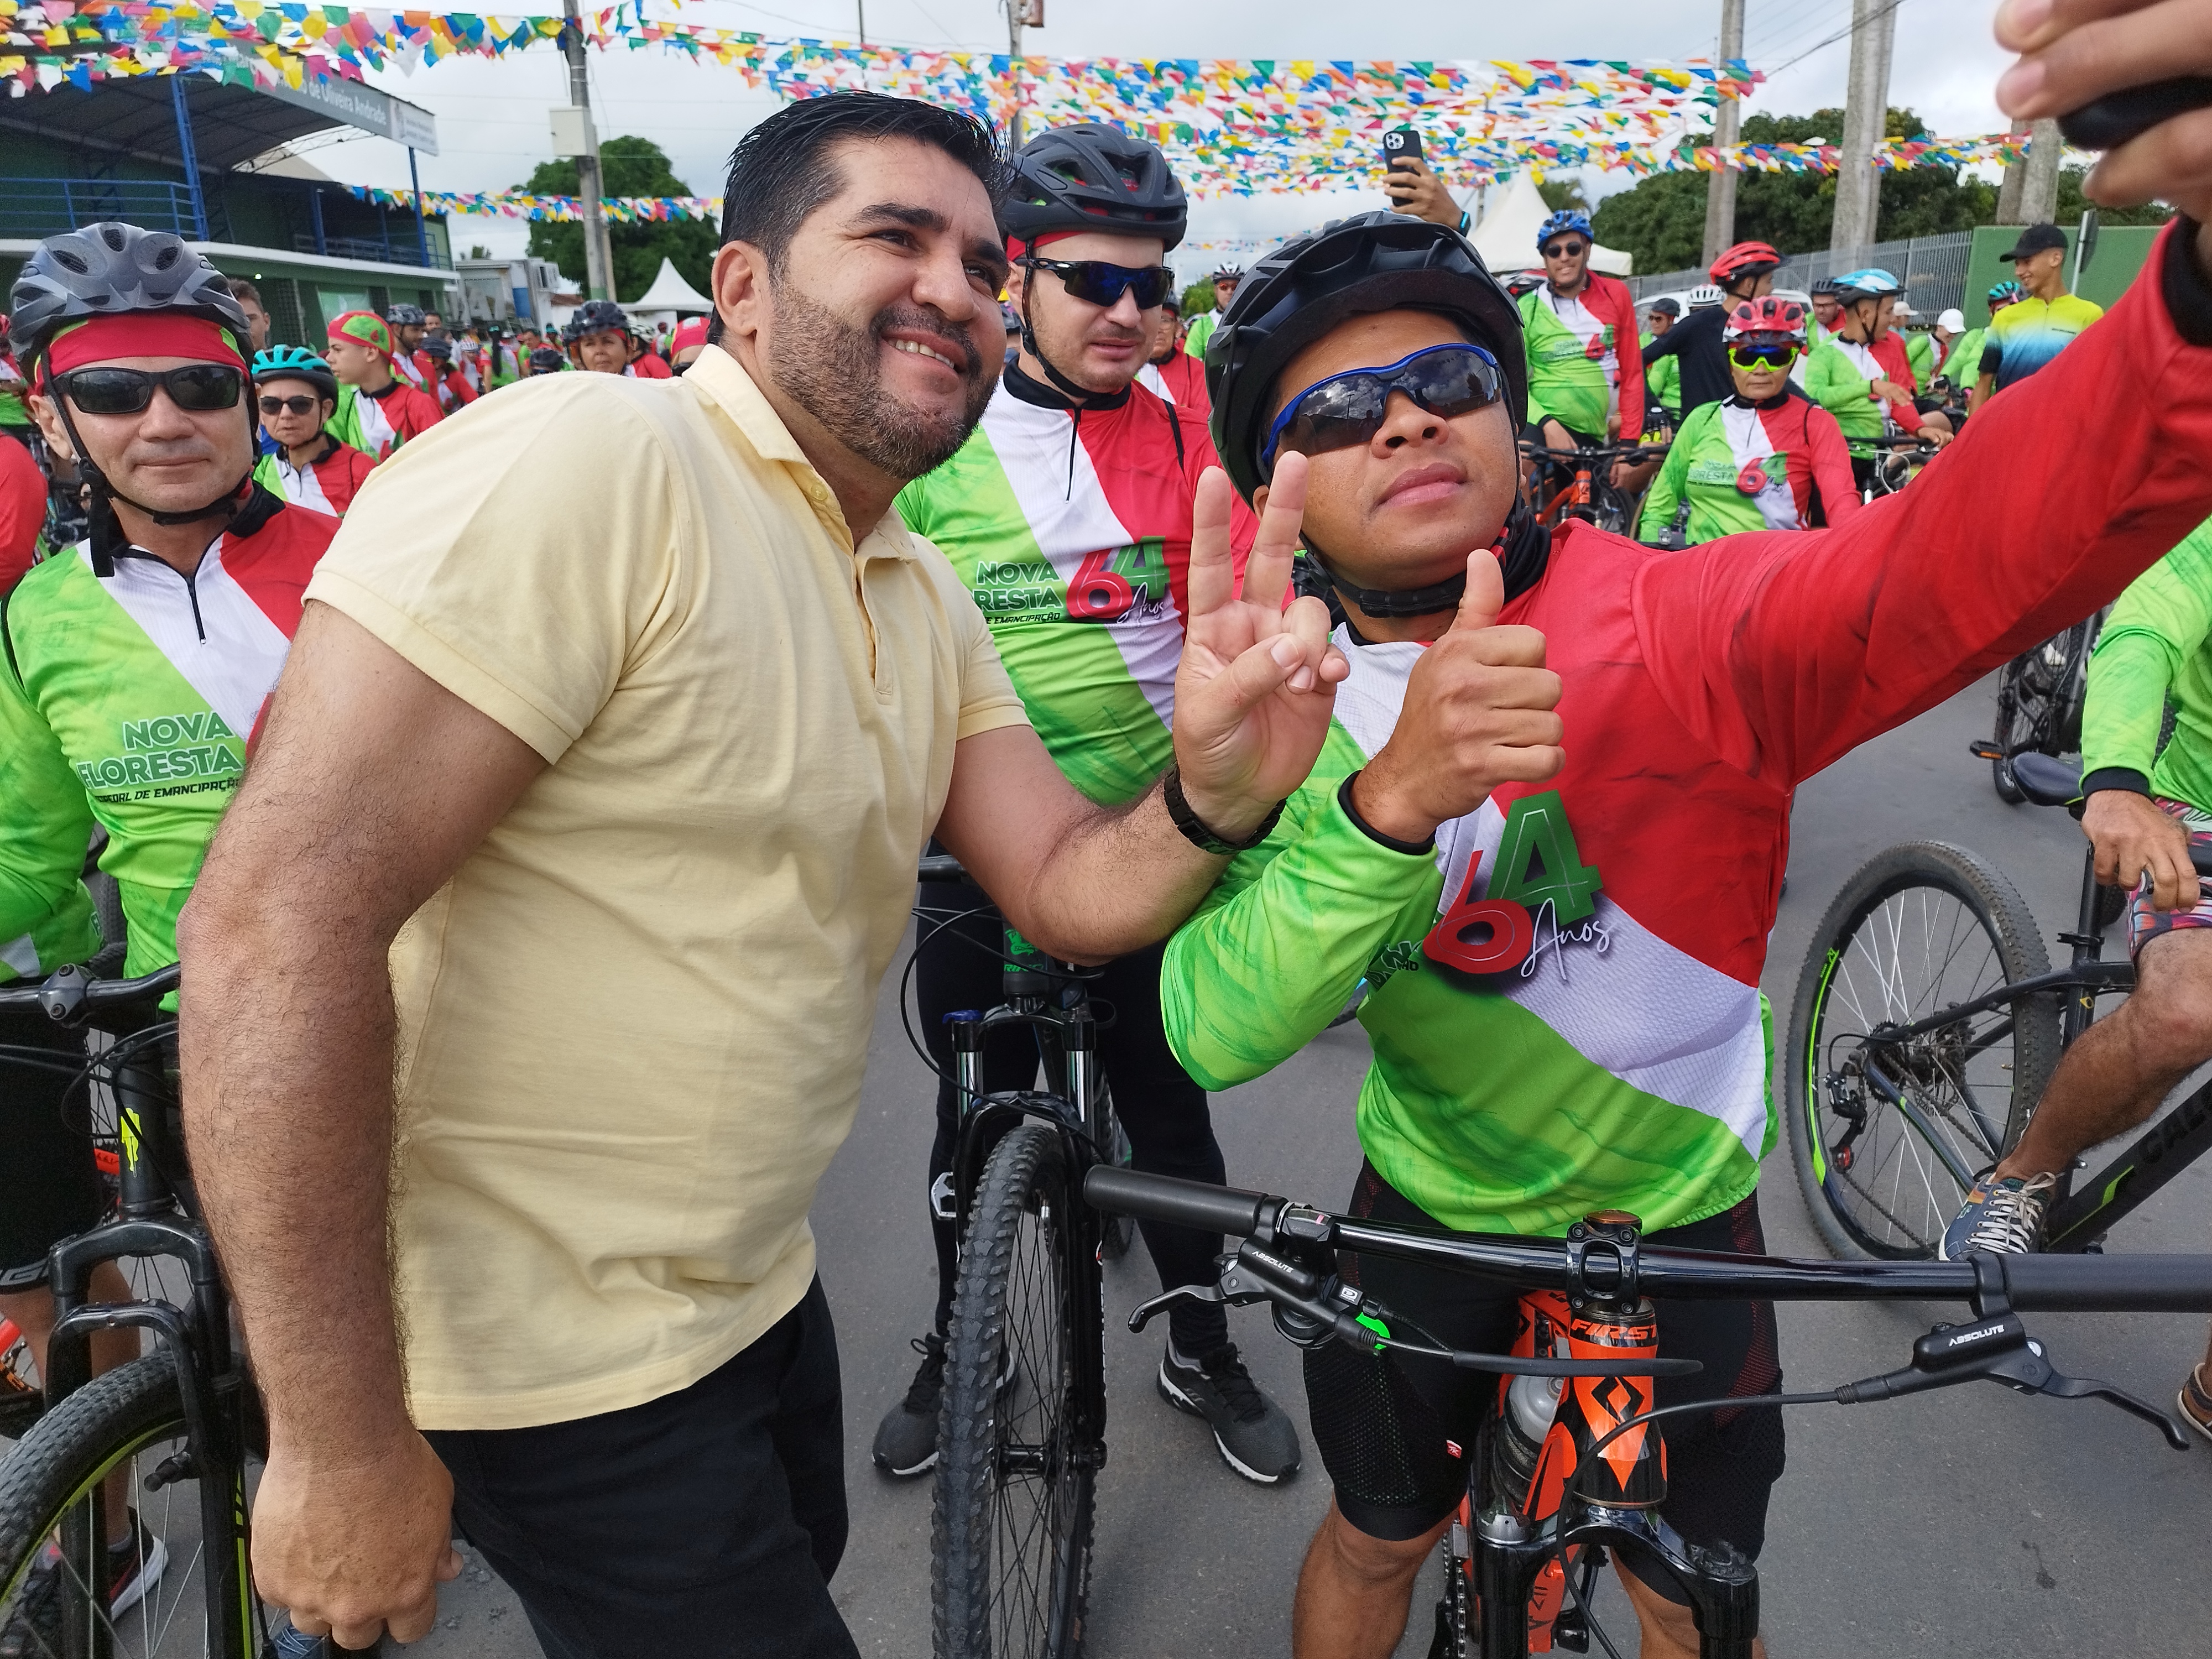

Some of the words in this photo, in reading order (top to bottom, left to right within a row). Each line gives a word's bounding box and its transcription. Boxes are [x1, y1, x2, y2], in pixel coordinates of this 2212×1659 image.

[1736, 451, 1789, 494] 64
[976, 560, 1063, 586] NOVA
[1066, 536, 1171, 619] 64
[969, 586, 1063, 612] RESTA
[994, 612, 1061, 625] EMANCIPAÇÃO
[1116, 582, 1165, 626] Anos
[124, 711, 235, 750] NOVA
[77, 744, 242, 789] FLORESTA
[134, 790, 151, 800] DE
[1423, 789, 1604, 974] 64
[1520, 897, 1617, 981] Anos
[1251, 1250, 1295, 1274] ABSOLUTE
[1948, 1324, 2005, 1347] ABSOLUTE
